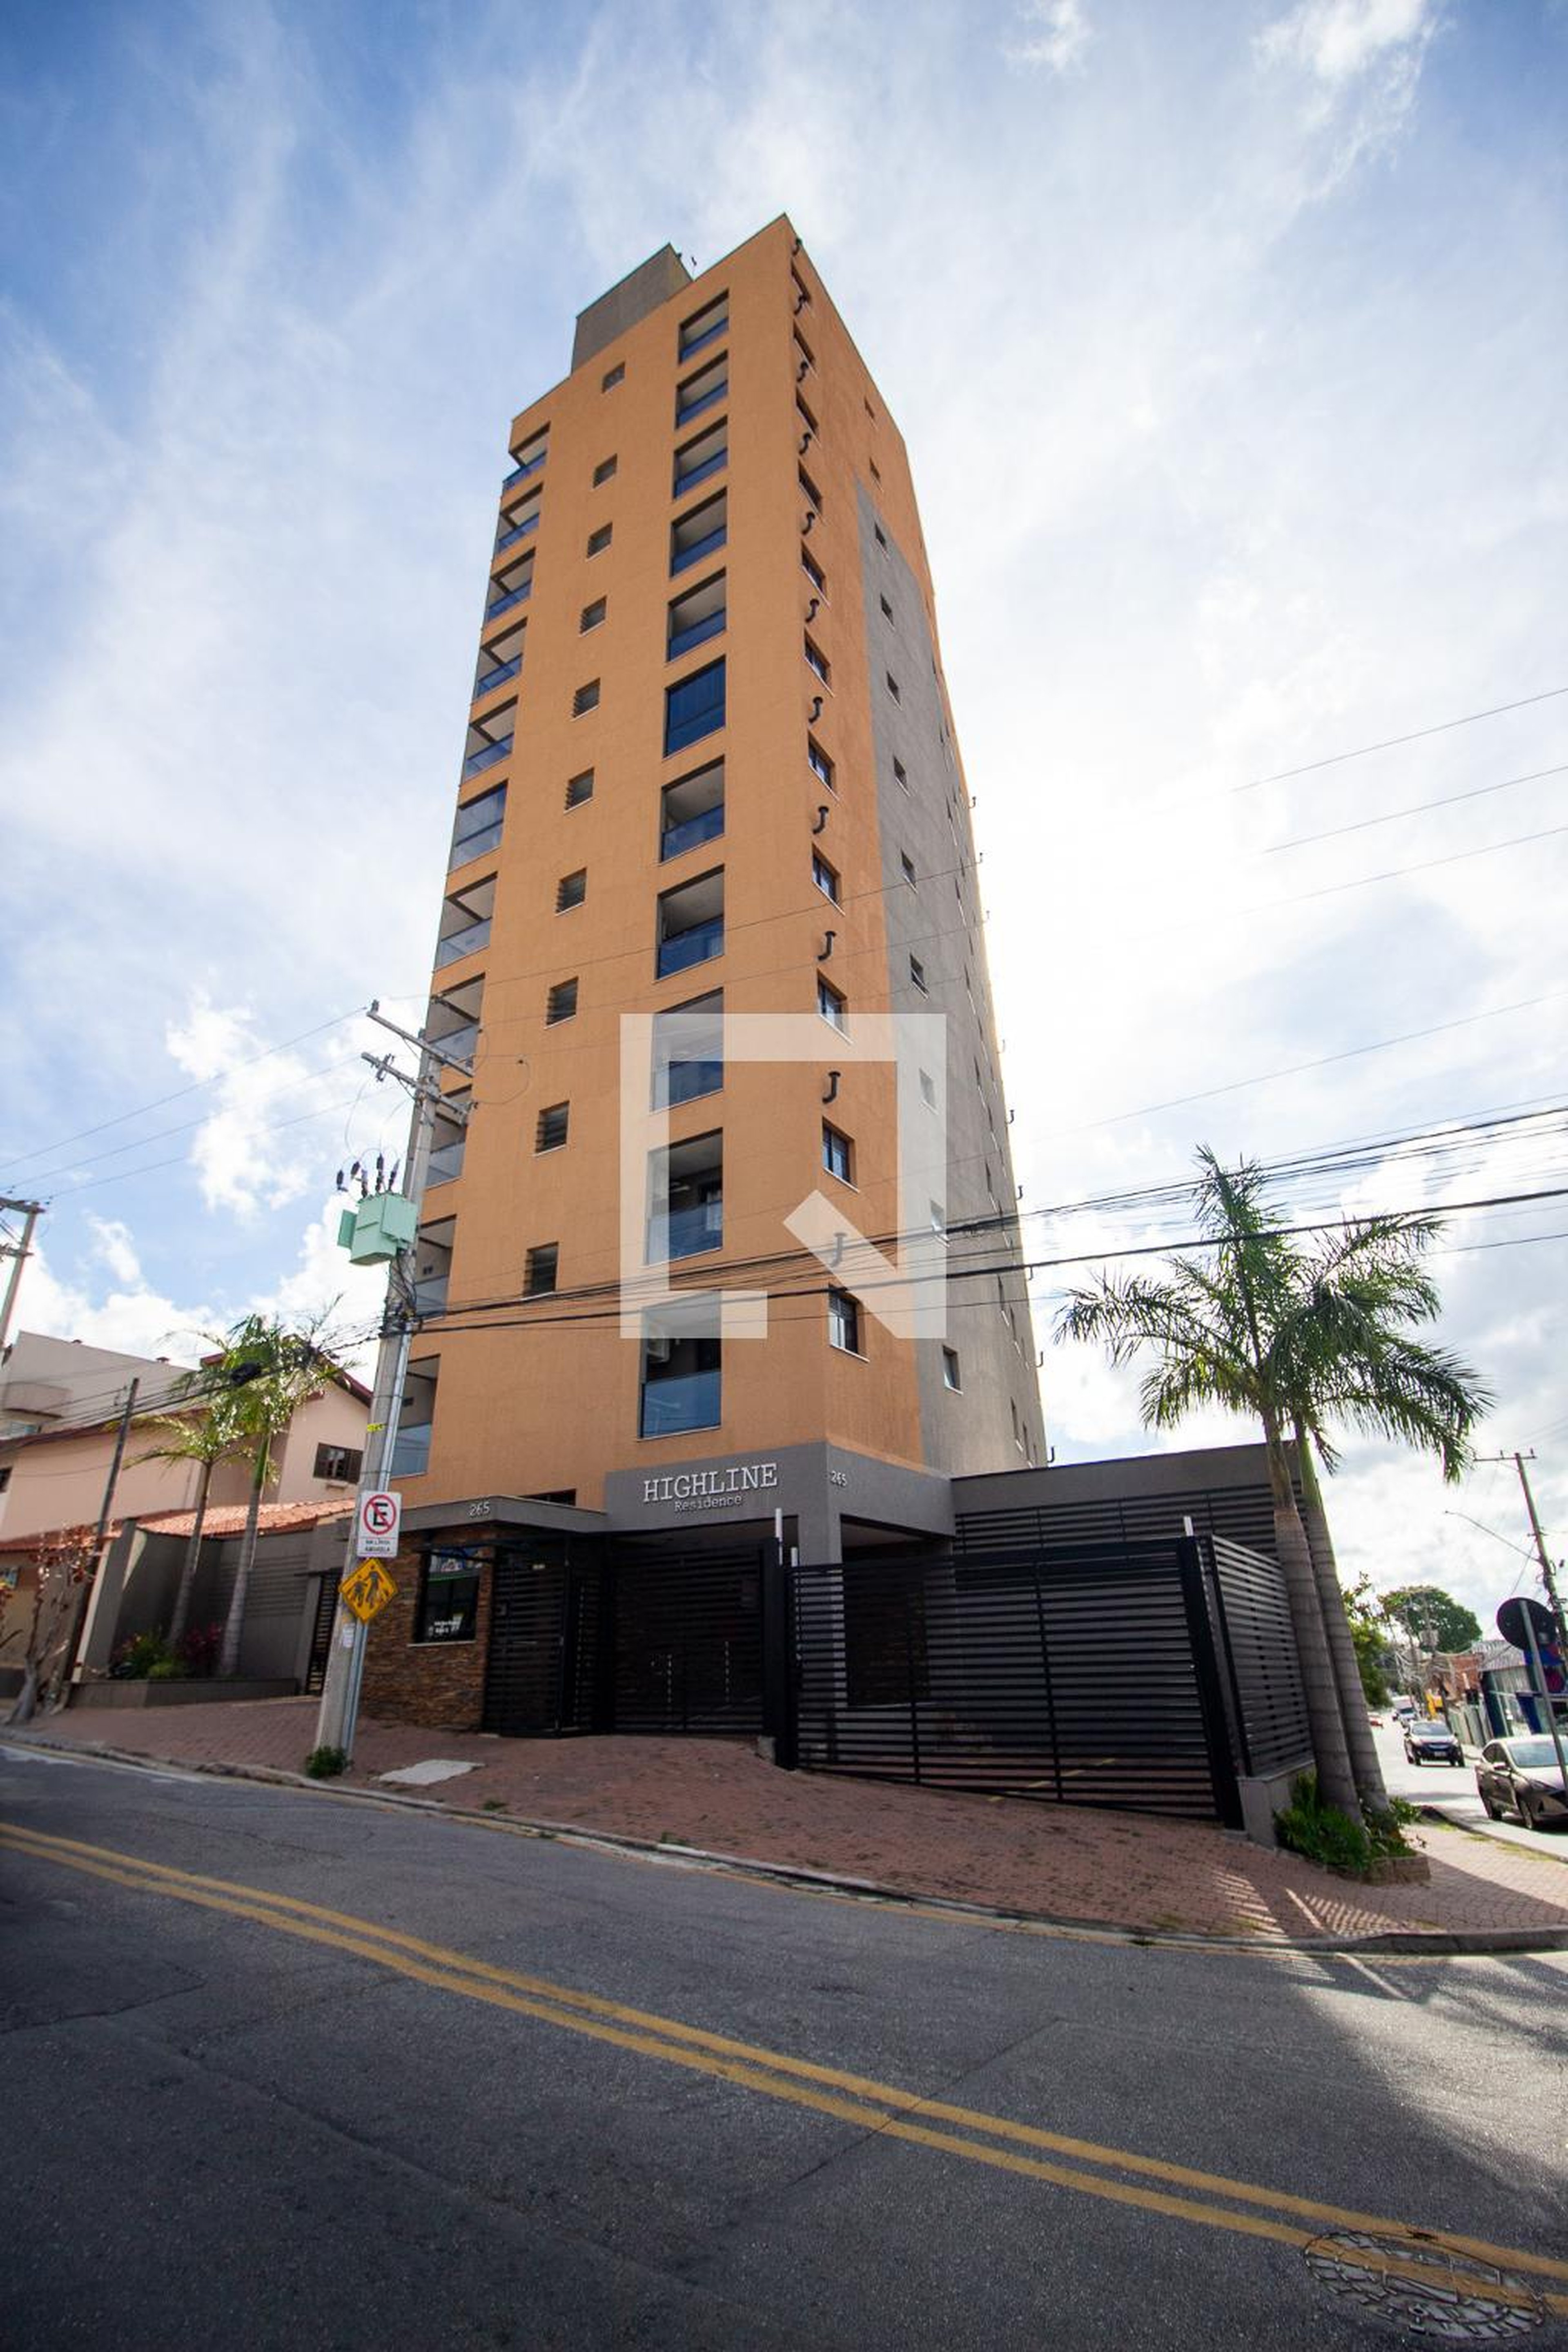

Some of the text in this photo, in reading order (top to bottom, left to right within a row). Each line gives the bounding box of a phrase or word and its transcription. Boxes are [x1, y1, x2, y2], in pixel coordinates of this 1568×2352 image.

[643, 1463, 777, 1503] HIGHLINE
[831, 1470, 848, 1486] 265
[467, 1501, 490, 1516] 265
[674, 1495, 742, 1512] Residence
[374, 1502, 388, 1526] E
